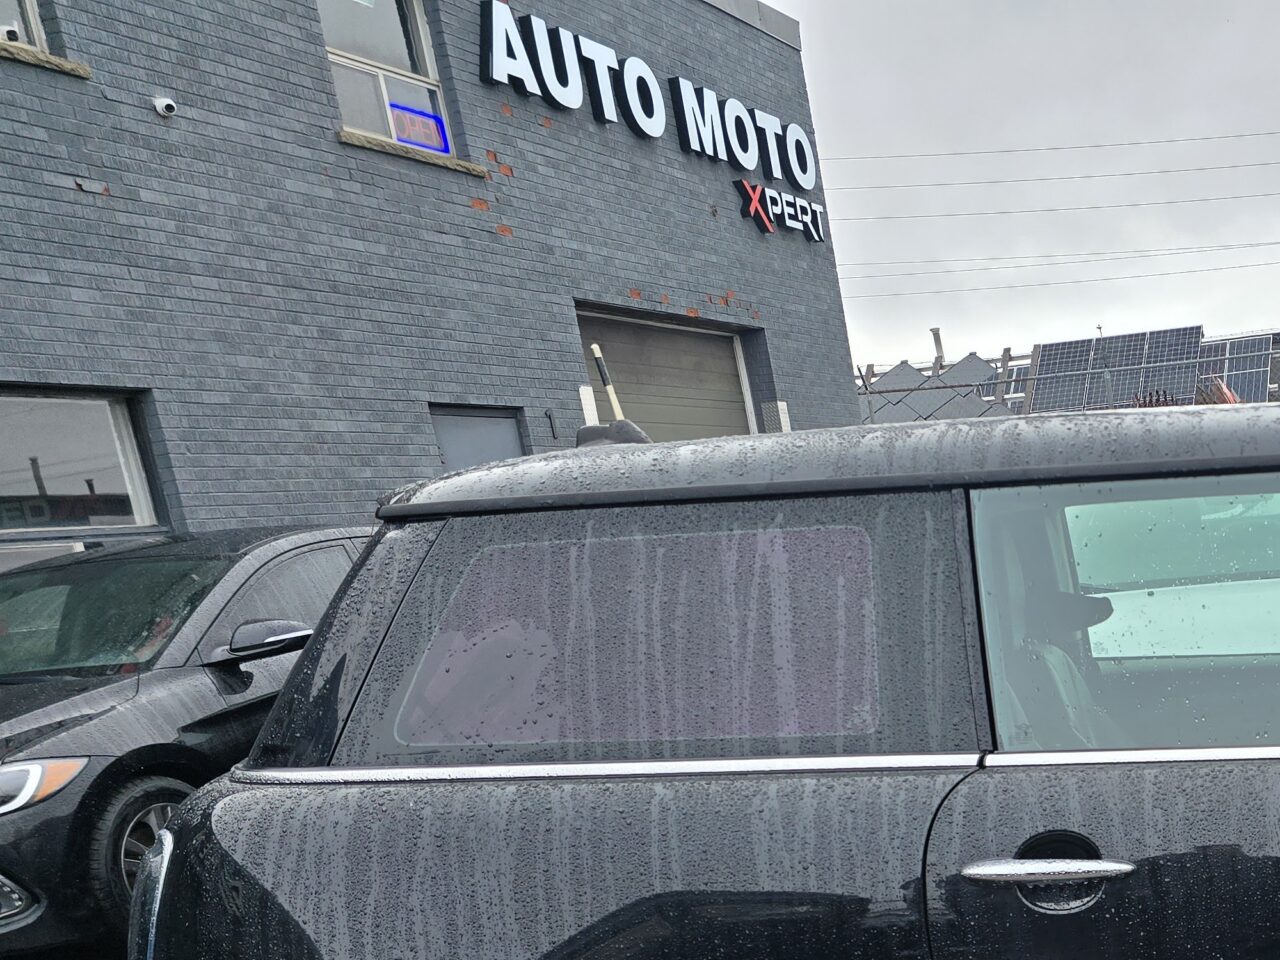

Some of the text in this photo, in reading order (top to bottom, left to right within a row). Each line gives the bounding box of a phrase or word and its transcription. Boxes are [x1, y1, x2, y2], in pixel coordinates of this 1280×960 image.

[490, 0, 816, 190] AUTO MOTO
[740, 178, 825, 242] XPERT
